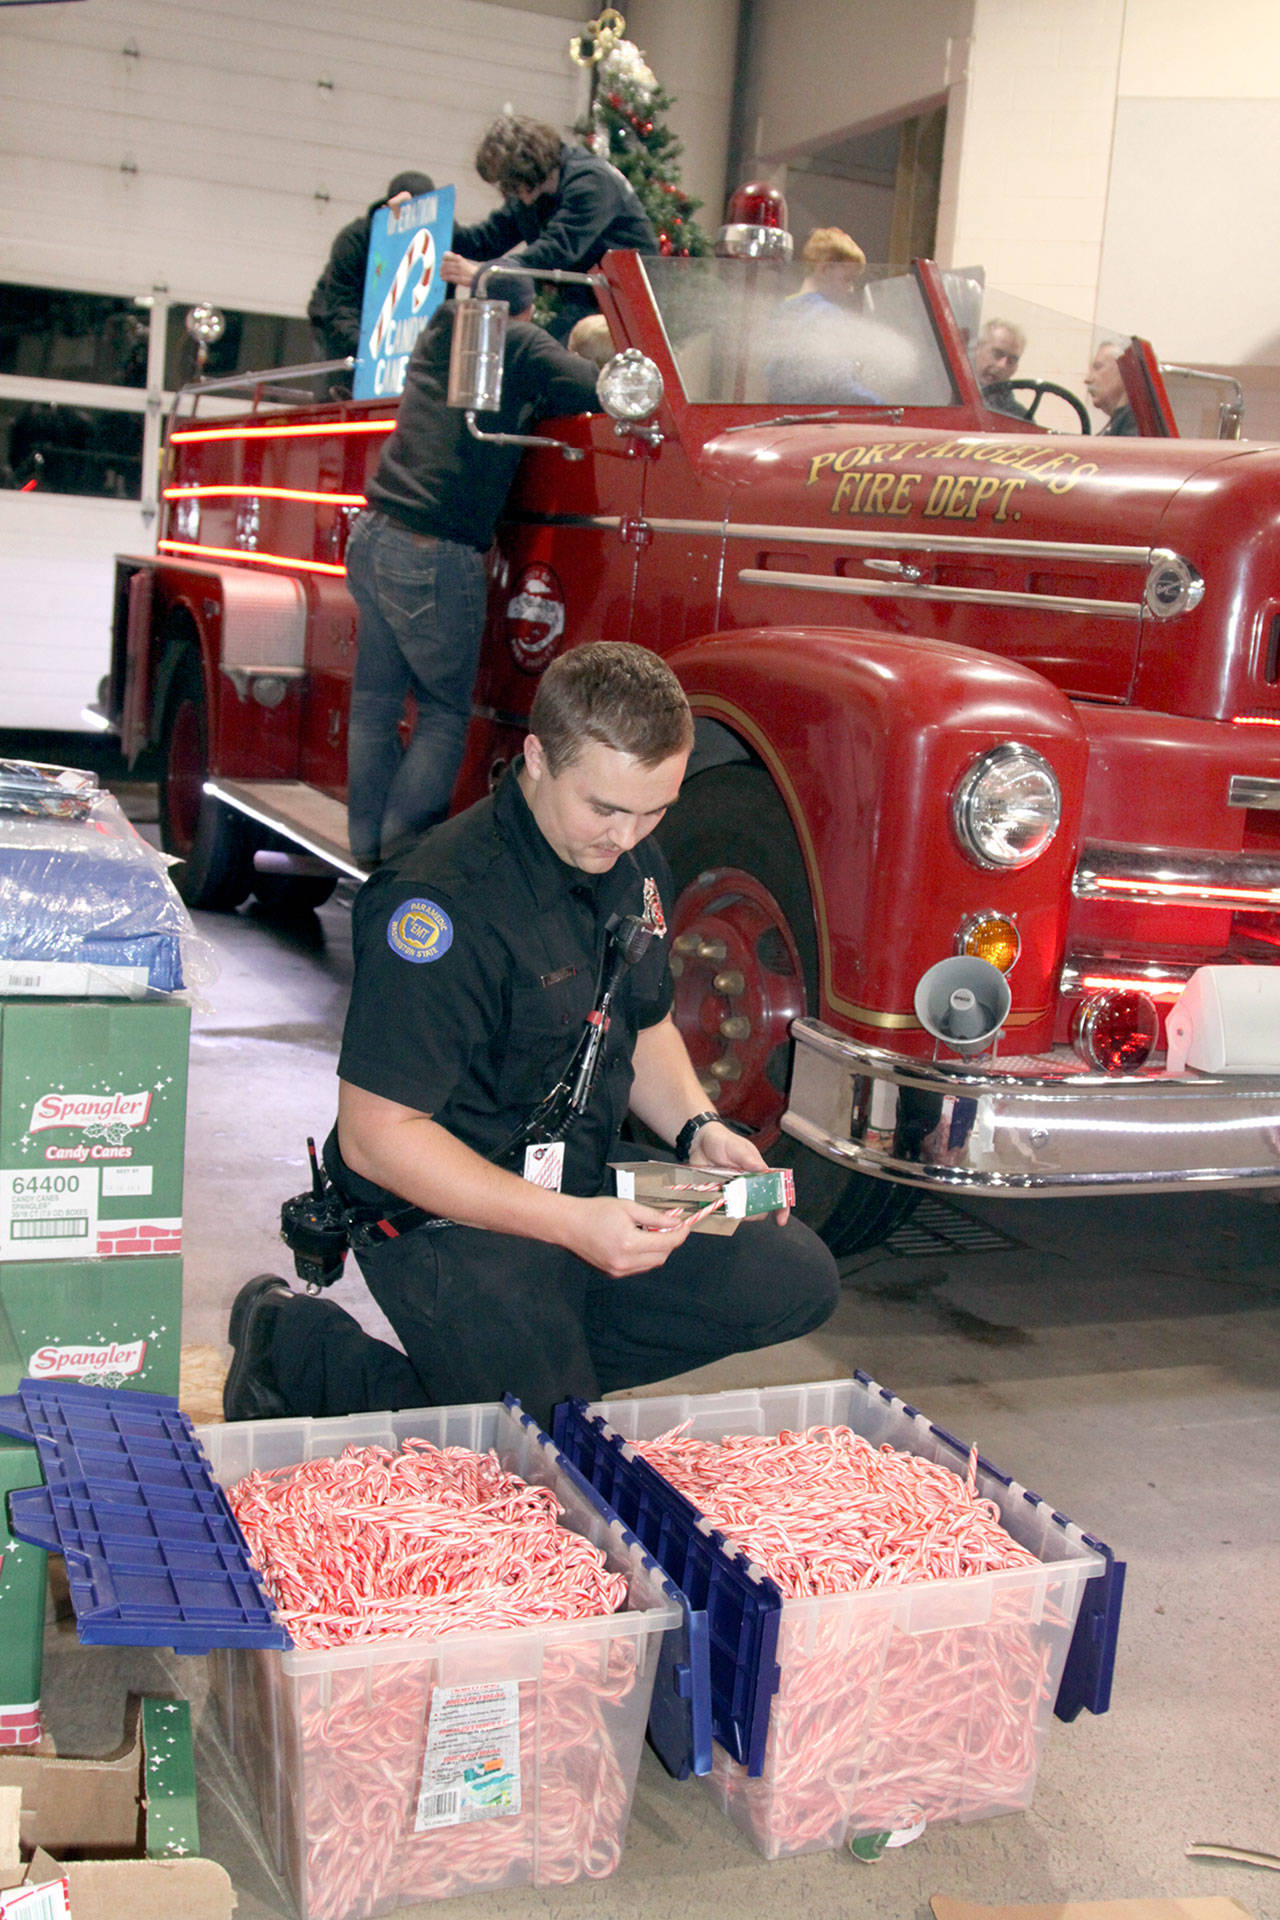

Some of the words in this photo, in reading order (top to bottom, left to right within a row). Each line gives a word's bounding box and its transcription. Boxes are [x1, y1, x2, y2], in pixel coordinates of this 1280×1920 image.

[806, 441, 926, 486] PORT
[915, 439, 1099, 495] ANGELES
[831, 472, 921, 515] FIRE
[924, 476, 1025, 521] DEPT.
[410, 902, 448, 932] PARAMEDIC
[391, 920, 416, 957] WASGTON
[416, 947, 439, 958] STATE
[410, 923, 430, 939] EMT
[38, 1095, 143, 1121] Spangler
[45, 1144, 90, 1162] Candy
[90, 1144, 133, 1160] Canes
[12, 1175, 80, 1194] 64400
[12, 1195, 34, 1203] CANDY
[37, 1194, 59, 1202] CANES
[34, 1345, 138, 1371] Spangler
